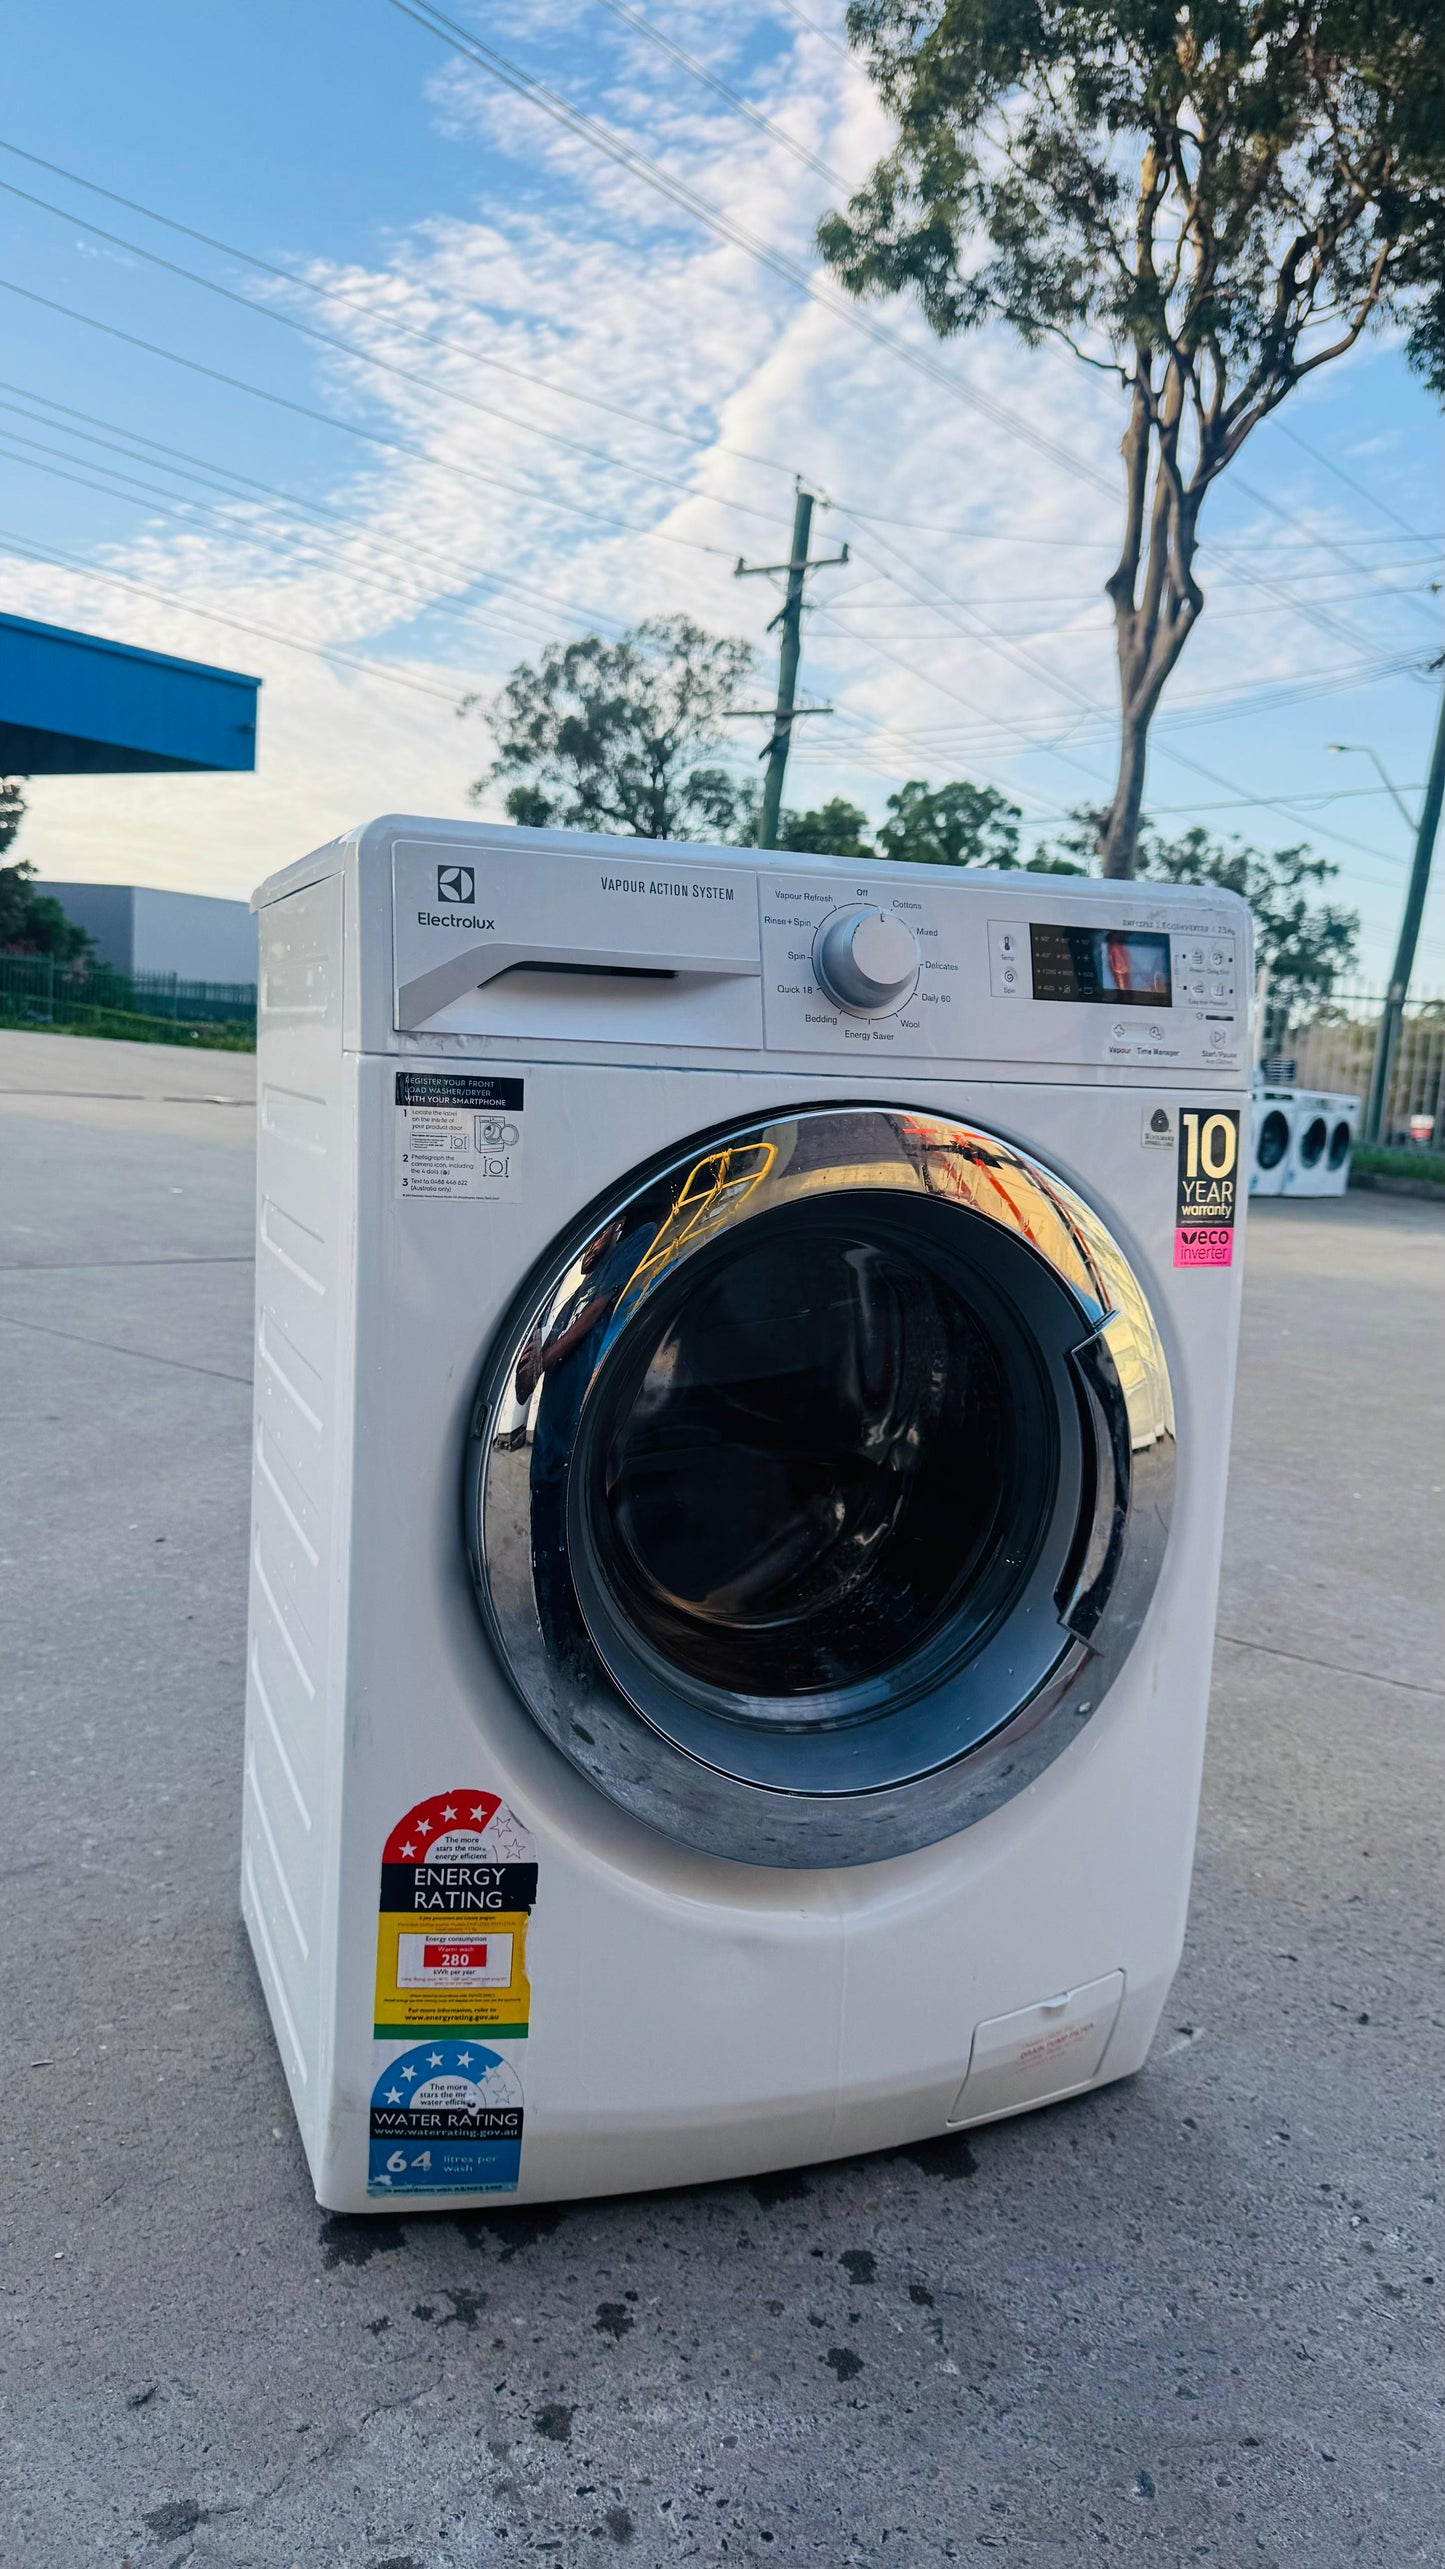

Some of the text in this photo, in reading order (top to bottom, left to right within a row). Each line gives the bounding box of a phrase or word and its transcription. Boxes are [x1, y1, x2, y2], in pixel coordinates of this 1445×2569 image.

[601, 877, 734, 900] VAPOUR ACTION SYSTEM
[856, 889, 868, 897] Off
[775, 891, 833, 902] Vapour Refresh
[892, 900, 921, 910] Cottons
[418, 912, 495, 930] Electrolux
[917, 928, 938, 937] Mixed
[788, 952, 806, 961] Spin
[925, 961, 958, 971] Delicates
[777, 985, 813, 994] Quick 18
[922, 994, 951, 1003] Daily 60
[805, 1014, 838, 1025] Bedding
[901, 1020, 920, 1028] Wool
[845, 1030, 894, 1041] Energy Saver
[1153, 1048, 1180, 1057] Manager
[429, 1087, 491, 1096] WASHER/DRYER
[404, 1095, 425, 1103] WITH
[452, 1098, 506, 1106] SMARTPHONE
[403, 1109, 407, 1117] 1
[1183, 1114, 1236, 1179] 10
[403, 1154, 409, 1162] 2
[402, 1178, 408, 1186] 3
[1182, 1180, 1233, 1203] YEAR
[1181, 1202, 1232, 1219] warranty
[1198, 1231, 1229, 1244] eco
[1180, 1246, 1228, 1260] inverter
[414, 1868, 506, 1886] ENERGY
[414, 1891, 503, 1909] RATING
[442, 1954, 469, 1966] 280
[374, 2113, 518, 2126] WATER RATING
[374, 2128, 518, 2137] www.waterrating.gov.au
[443, 2155, 474, 2163] litres
[477, 2155, 497, 2165] per
[443, 2164, 474, 2172] wash
